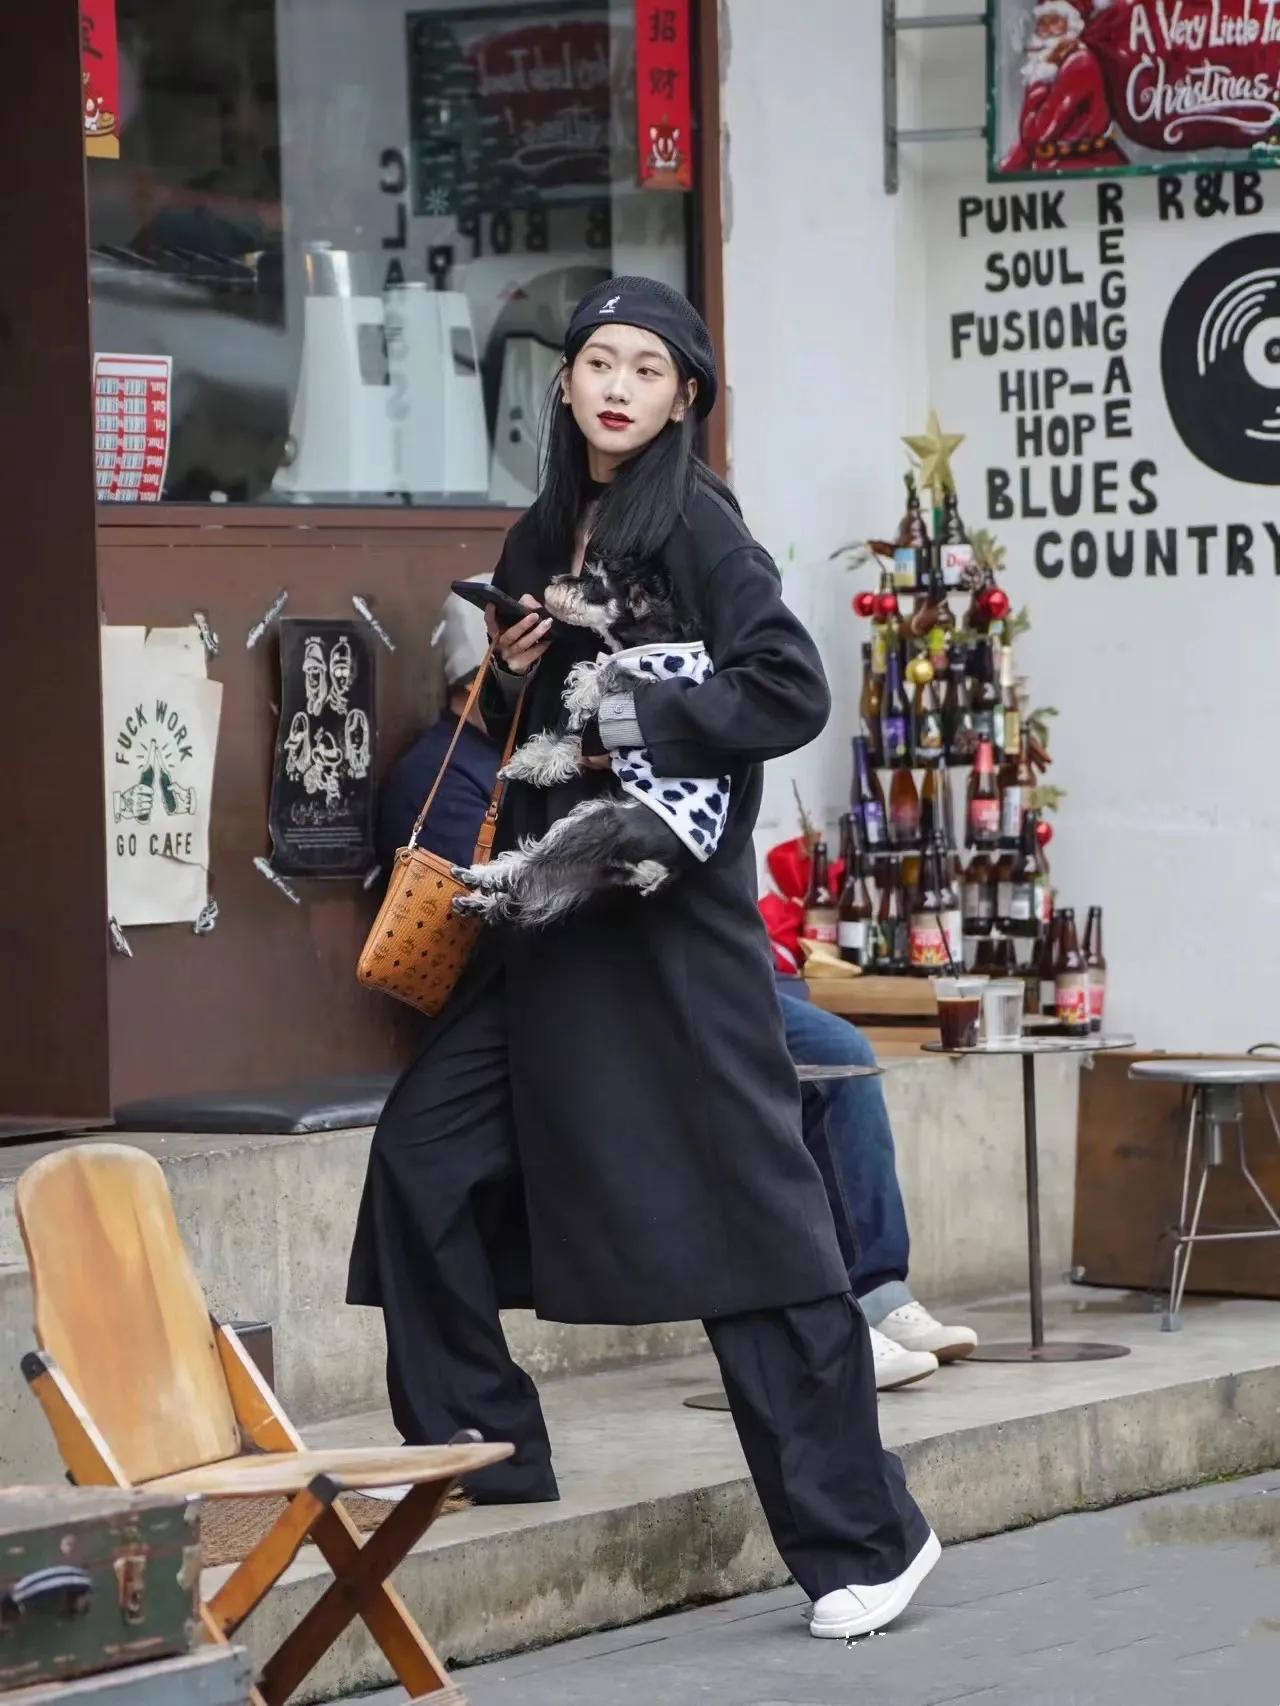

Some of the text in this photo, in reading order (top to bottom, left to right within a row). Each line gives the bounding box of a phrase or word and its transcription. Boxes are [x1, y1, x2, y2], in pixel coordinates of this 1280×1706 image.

[1129, 2, 1156, 54] A
[1156, 0, 1207, 51] Very
[1208, 0, 1260, 47] Little
[958, 190, 1067, 237] PUNK
[1157, 171, 1264, 221] R&B
[985, 247, 1084, 292] SOUL
[951, 300, 1098, 358] FUSION
[1097, 183, 1133, 438] REGGAE
[1000, 368, 1094, 412] HIP-
[1016, 413, 1096, 457] HOP
[986, 459, 1159, 520] BLUES
[1035, 522, 1280, 579] COUNTRY
[115, 700, 193, 764] FUCK WORK
[116, 832, 192, 857] GO CAFE
